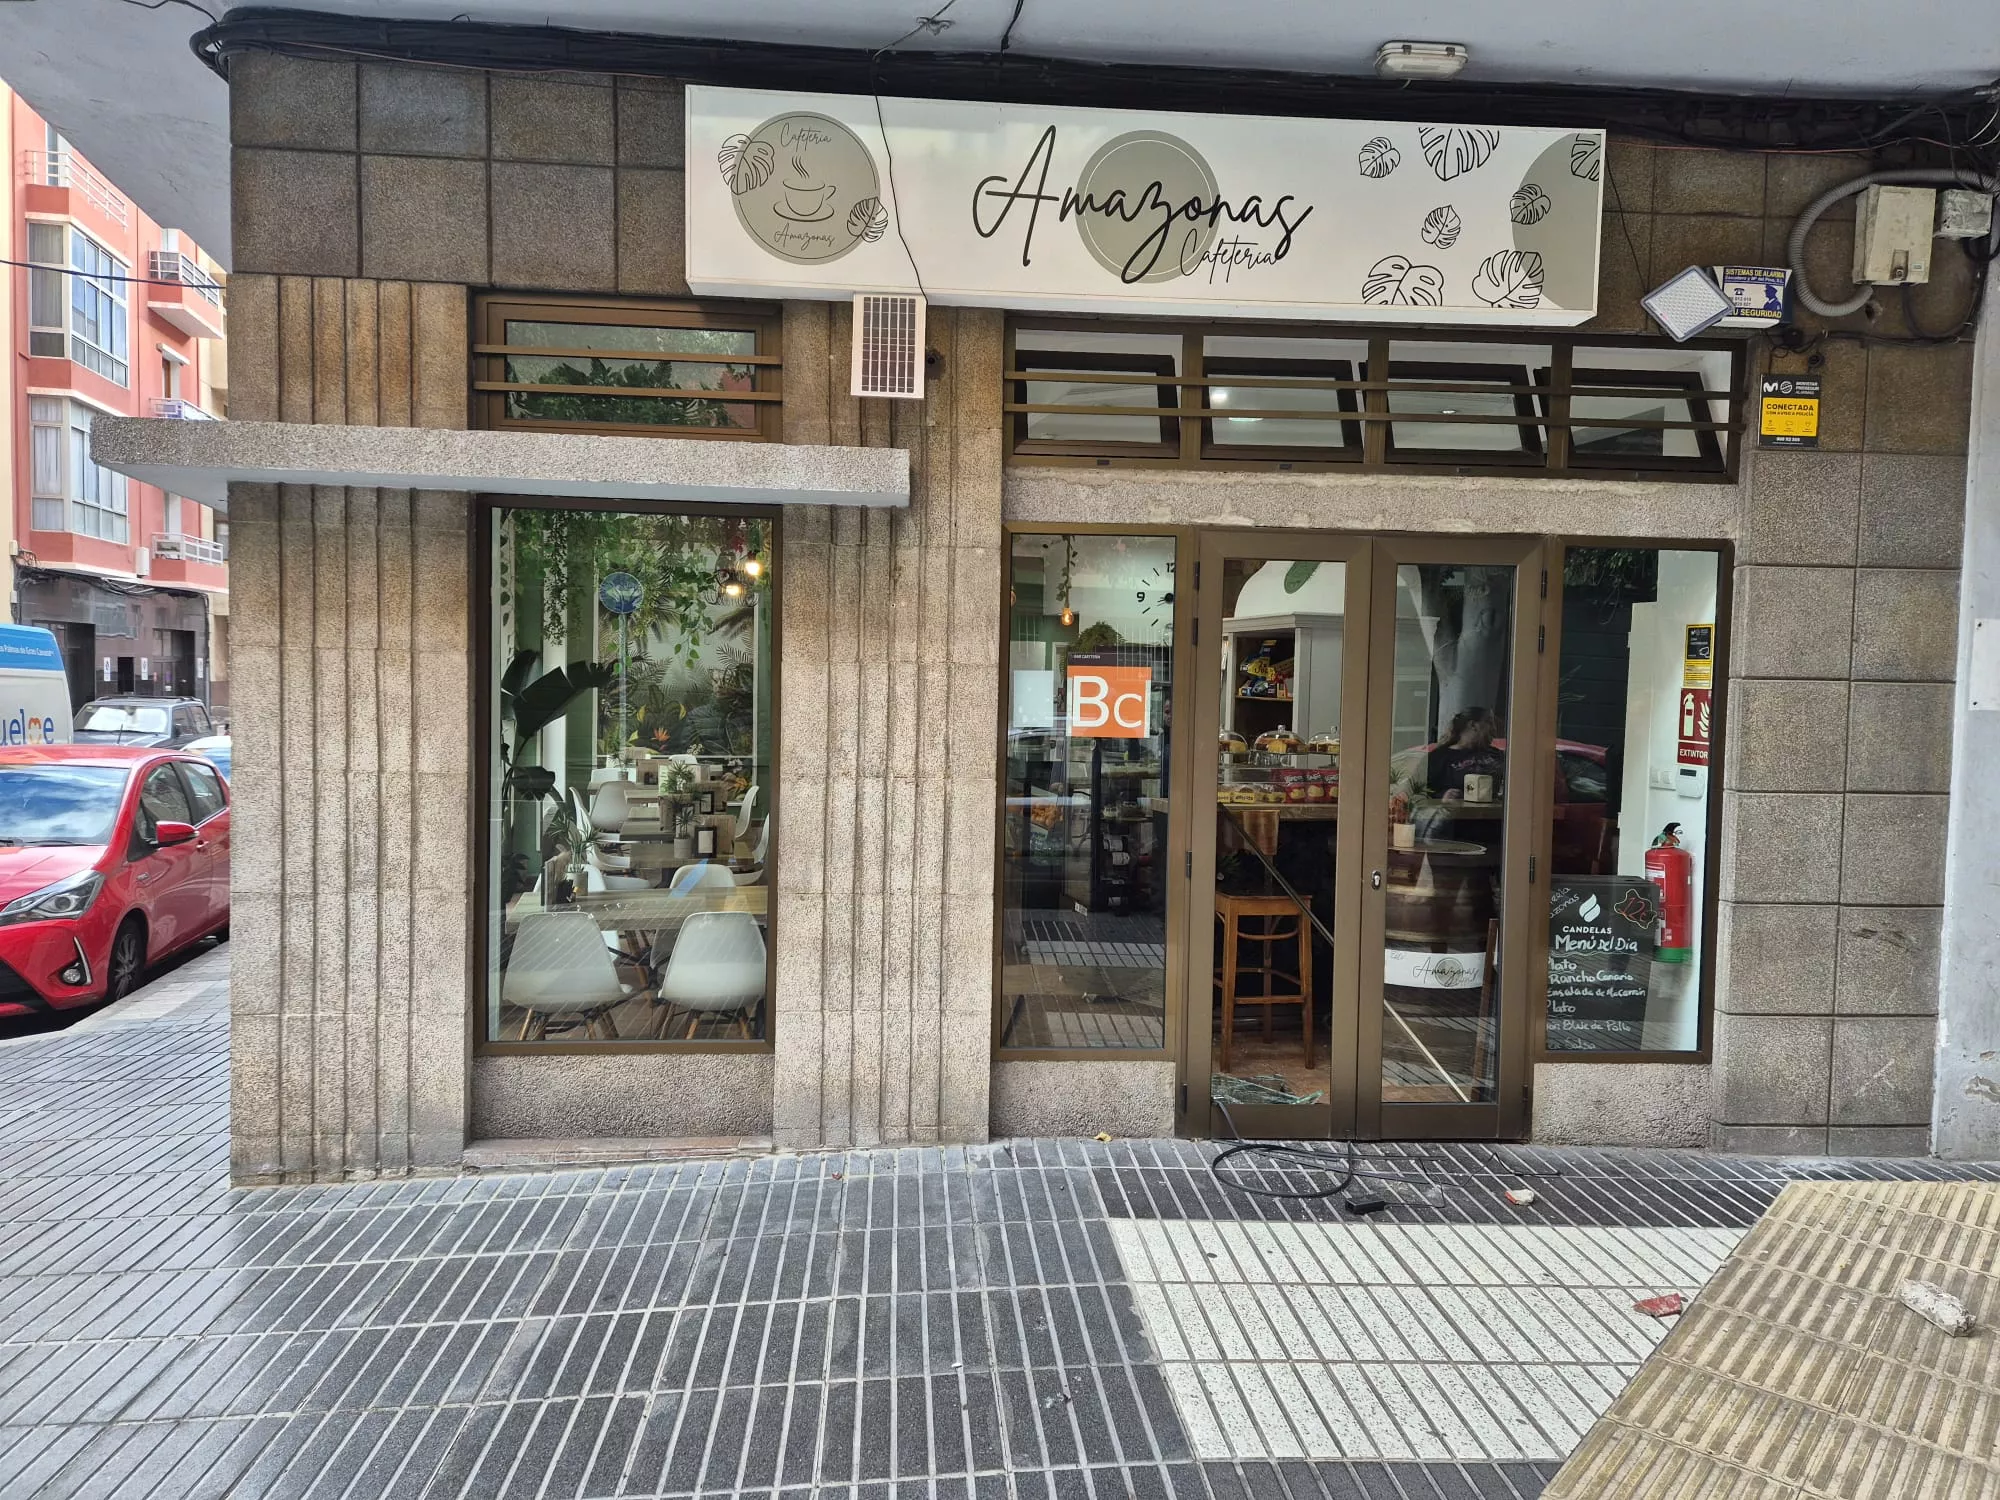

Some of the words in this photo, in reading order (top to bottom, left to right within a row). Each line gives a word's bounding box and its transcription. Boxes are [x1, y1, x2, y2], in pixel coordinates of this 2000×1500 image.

[972, 125, 1314, 284] Amazonas
[774, 223, 835, 250] Amazonas
[1725, 268, 1753, 276] SISTEMAS
[1763, 271, 1785, 279] ALARMA
[1741, 309, 1782, 318] SEGURIDAD
[1136, 591, 1146, 603] 9
[1072, 675, 1142, 728] Bc
[1562, 925, 1613, 935] CANDELAS
[1549, 970, 1596, 984] Rancho
